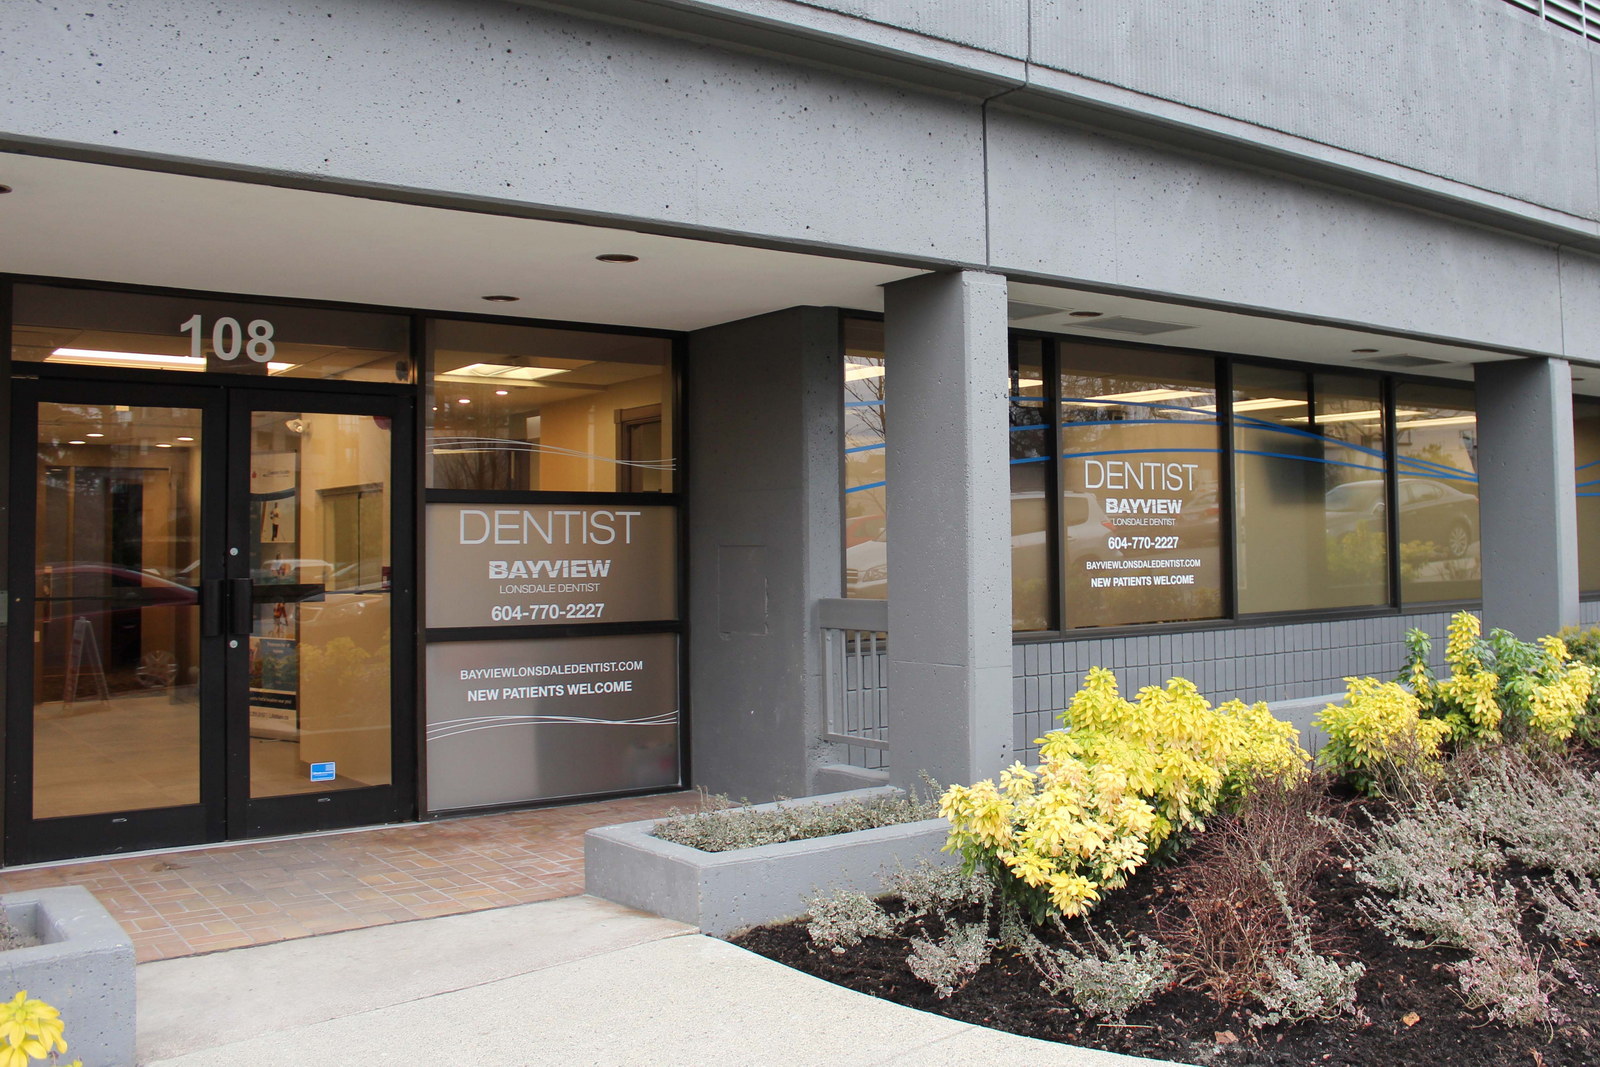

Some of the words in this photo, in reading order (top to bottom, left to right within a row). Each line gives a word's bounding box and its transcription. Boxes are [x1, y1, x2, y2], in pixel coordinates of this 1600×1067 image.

[180, 314, 275, 363] 108
[1084, 459, 1199, 491] DENTIST
[1105, 498, 1182, 514] BAYVIEW
[459, 509, 641, 545] DENTIST
[1112, 518, 1148, 526] LONSDALE
[1149, 518, 1176, 526] DENTIST
[1108, 536, 1179, 549] 604-770-2227
[488, 559, 611, 579] BAYVIEW
[1086, 559, 1201, 570] BAYVIEWLONSDALEDENTIST.COM
[499, 584, 556, 594] LONSDALE
[558, 583, 600, 593] DENTIST
[1091, 577, 1111, 588] NEW
[1113, 576, 1152, 587] PATIENTS
[1153, 575, 1195, 585] WELCOME
[491, 603, 605, 621] 604-770-2227
[460, 660, 643, 680] BAYVIEWLONSDALEDENTIST.COM
[467, 689, 499, 702] NEW
[503, 685, 565, 699] PATIENTS
[567, 680, 632, 696] WELCOME
